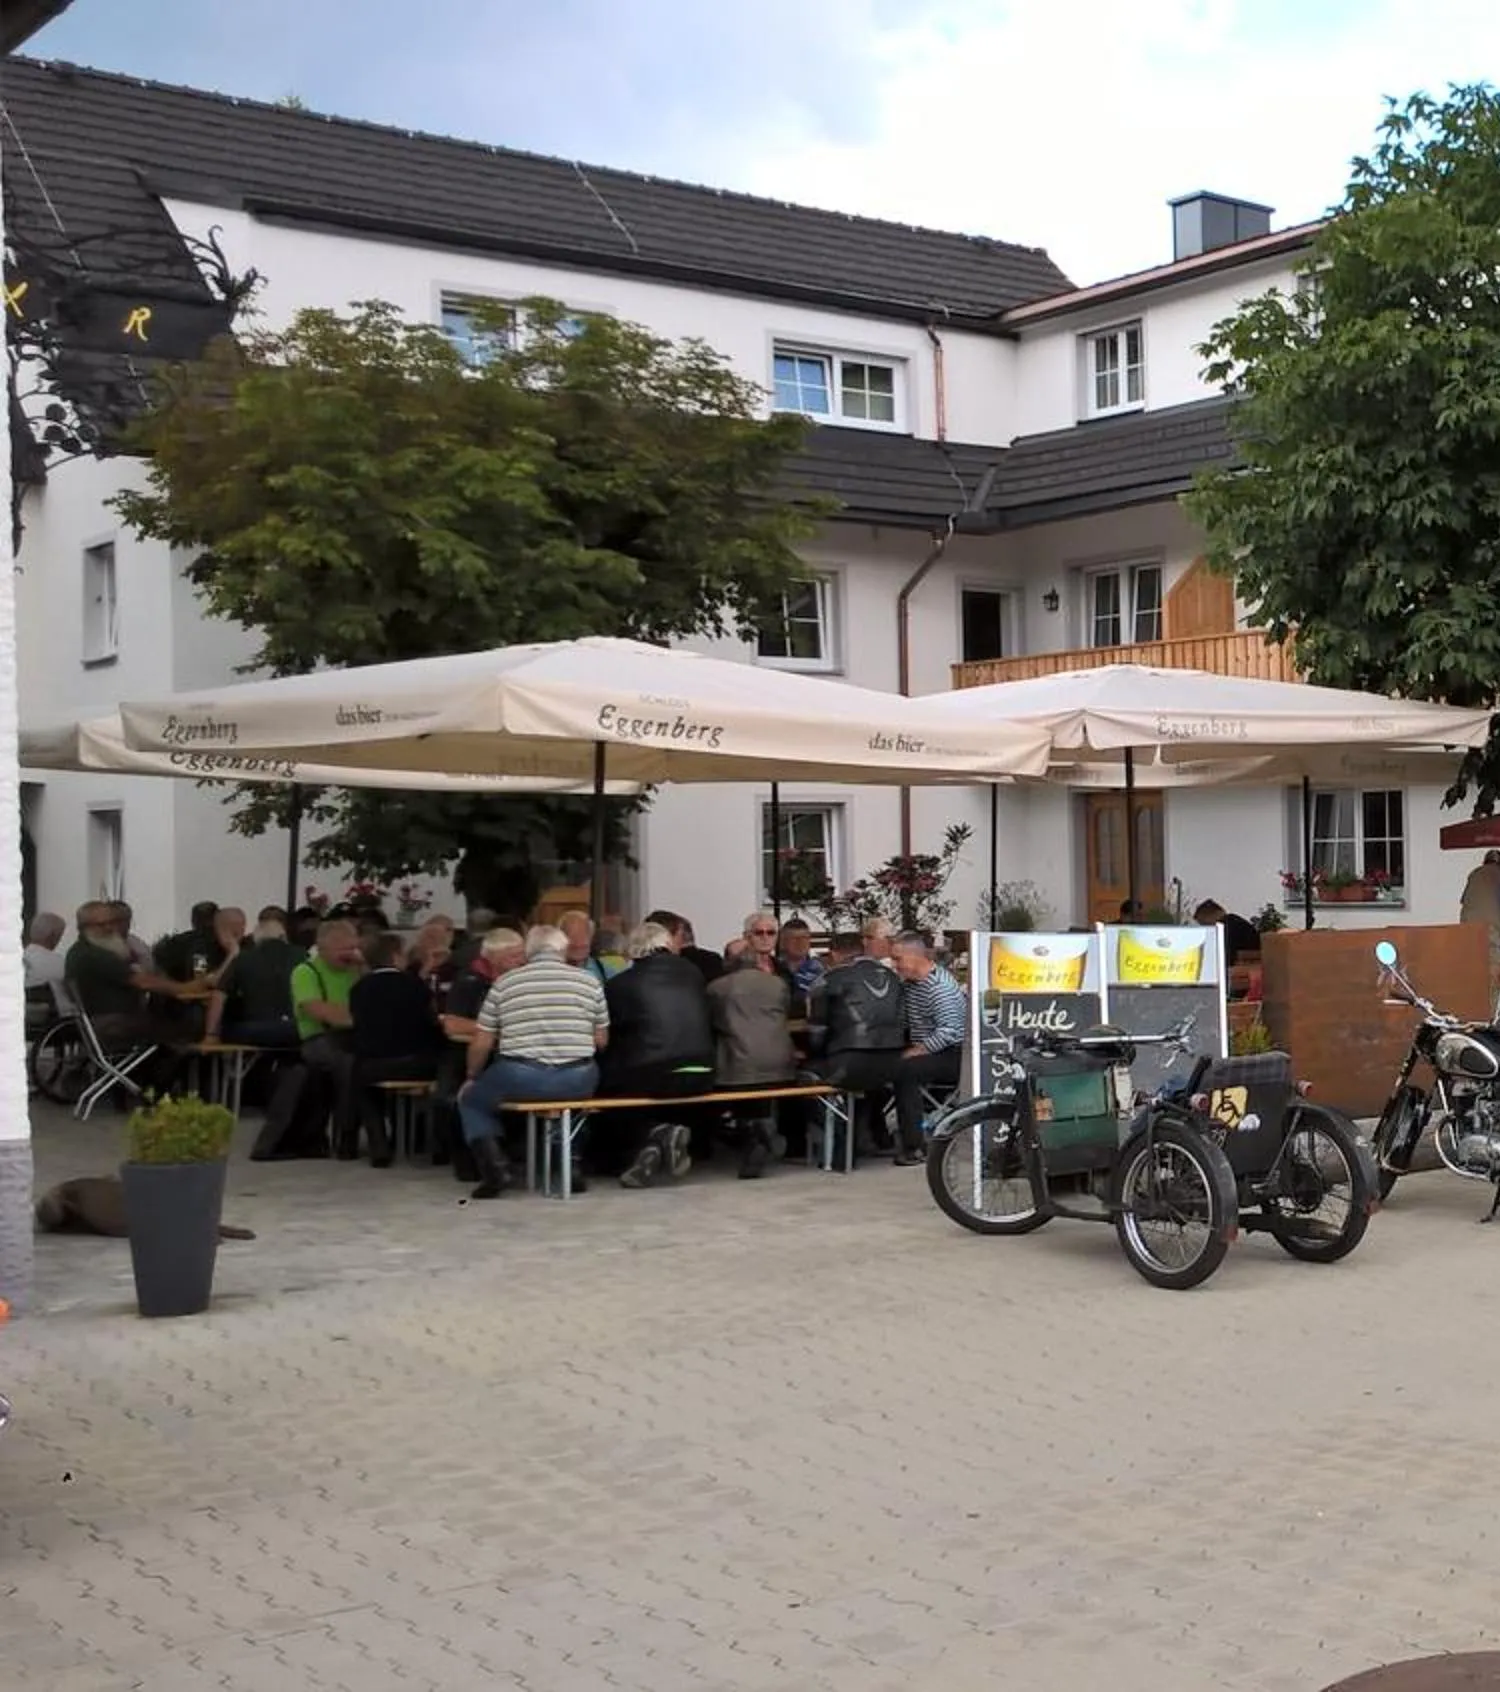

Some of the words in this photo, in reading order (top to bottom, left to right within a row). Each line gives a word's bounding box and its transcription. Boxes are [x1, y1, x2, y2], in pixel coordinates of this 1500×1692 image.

[161, 713, 239, 745] Eggenberg
[598, 703, 724, 748] Eggenberg
[868, 731, 893, 750] das
[896, 733, 925, 753] bier
